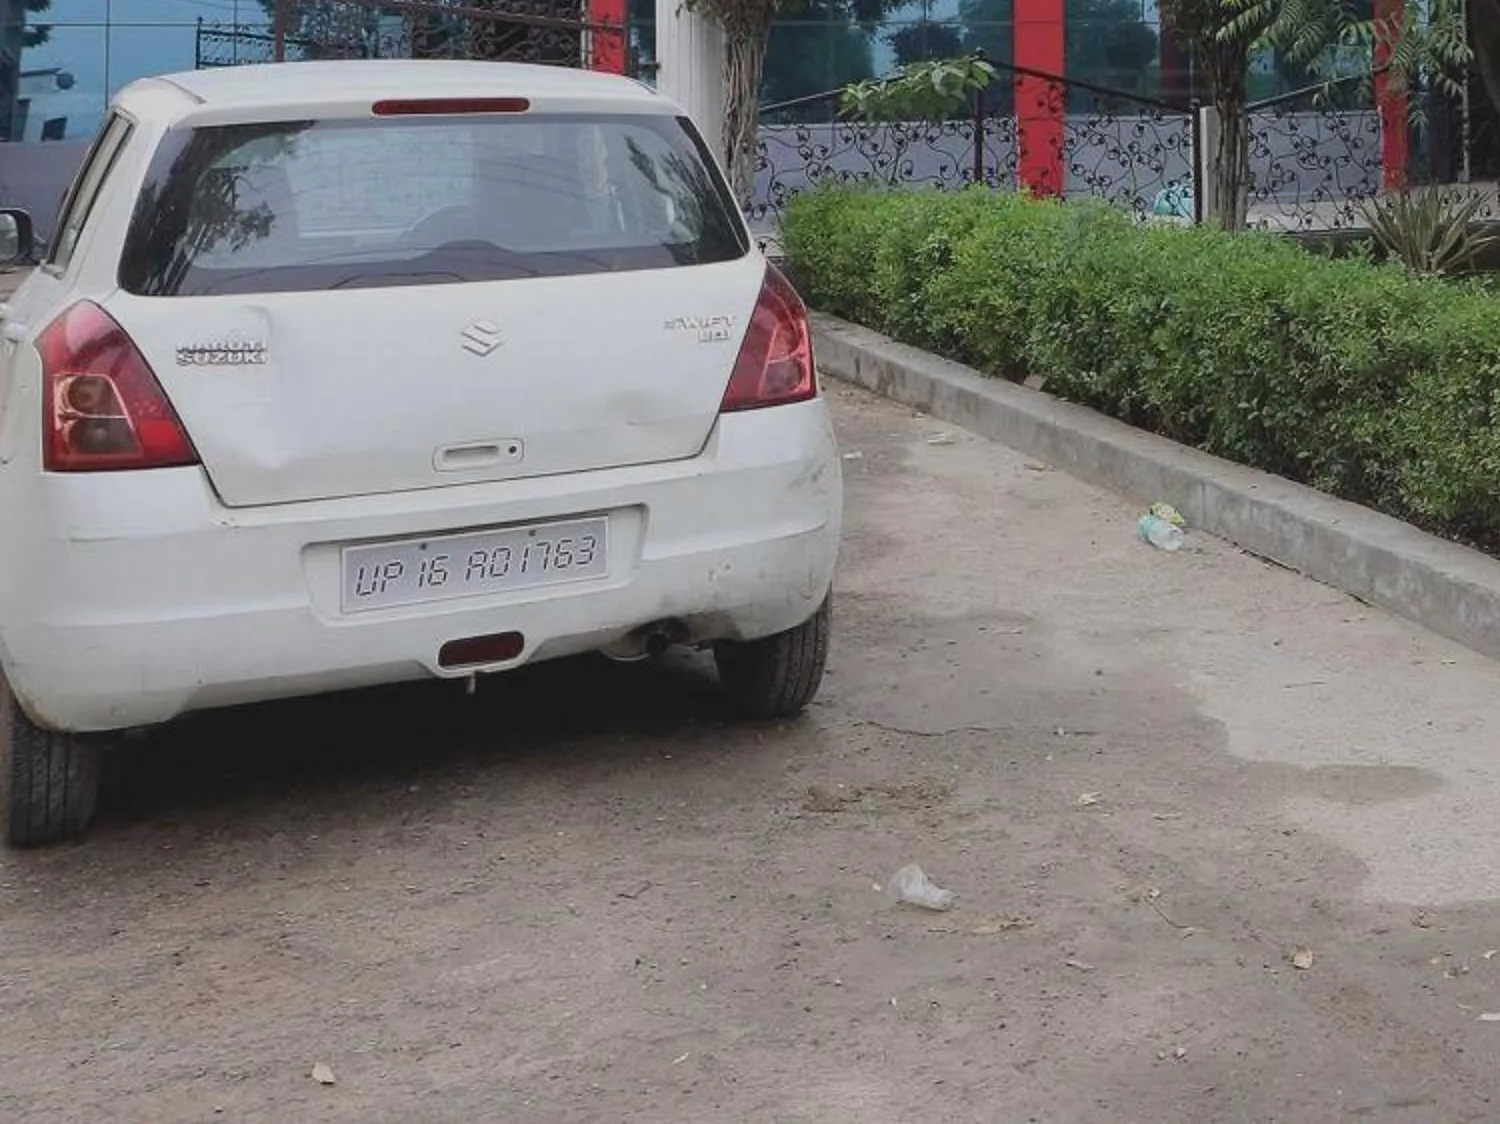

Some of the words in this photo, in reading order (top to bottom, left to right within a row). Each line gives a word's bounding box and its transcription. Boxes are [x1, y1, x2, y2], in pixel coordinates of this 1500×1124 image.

[176, 351, 271, 366] SUZUKI
[355, 560, 403, 597] UP
[418, 555, 448, 588] 16
